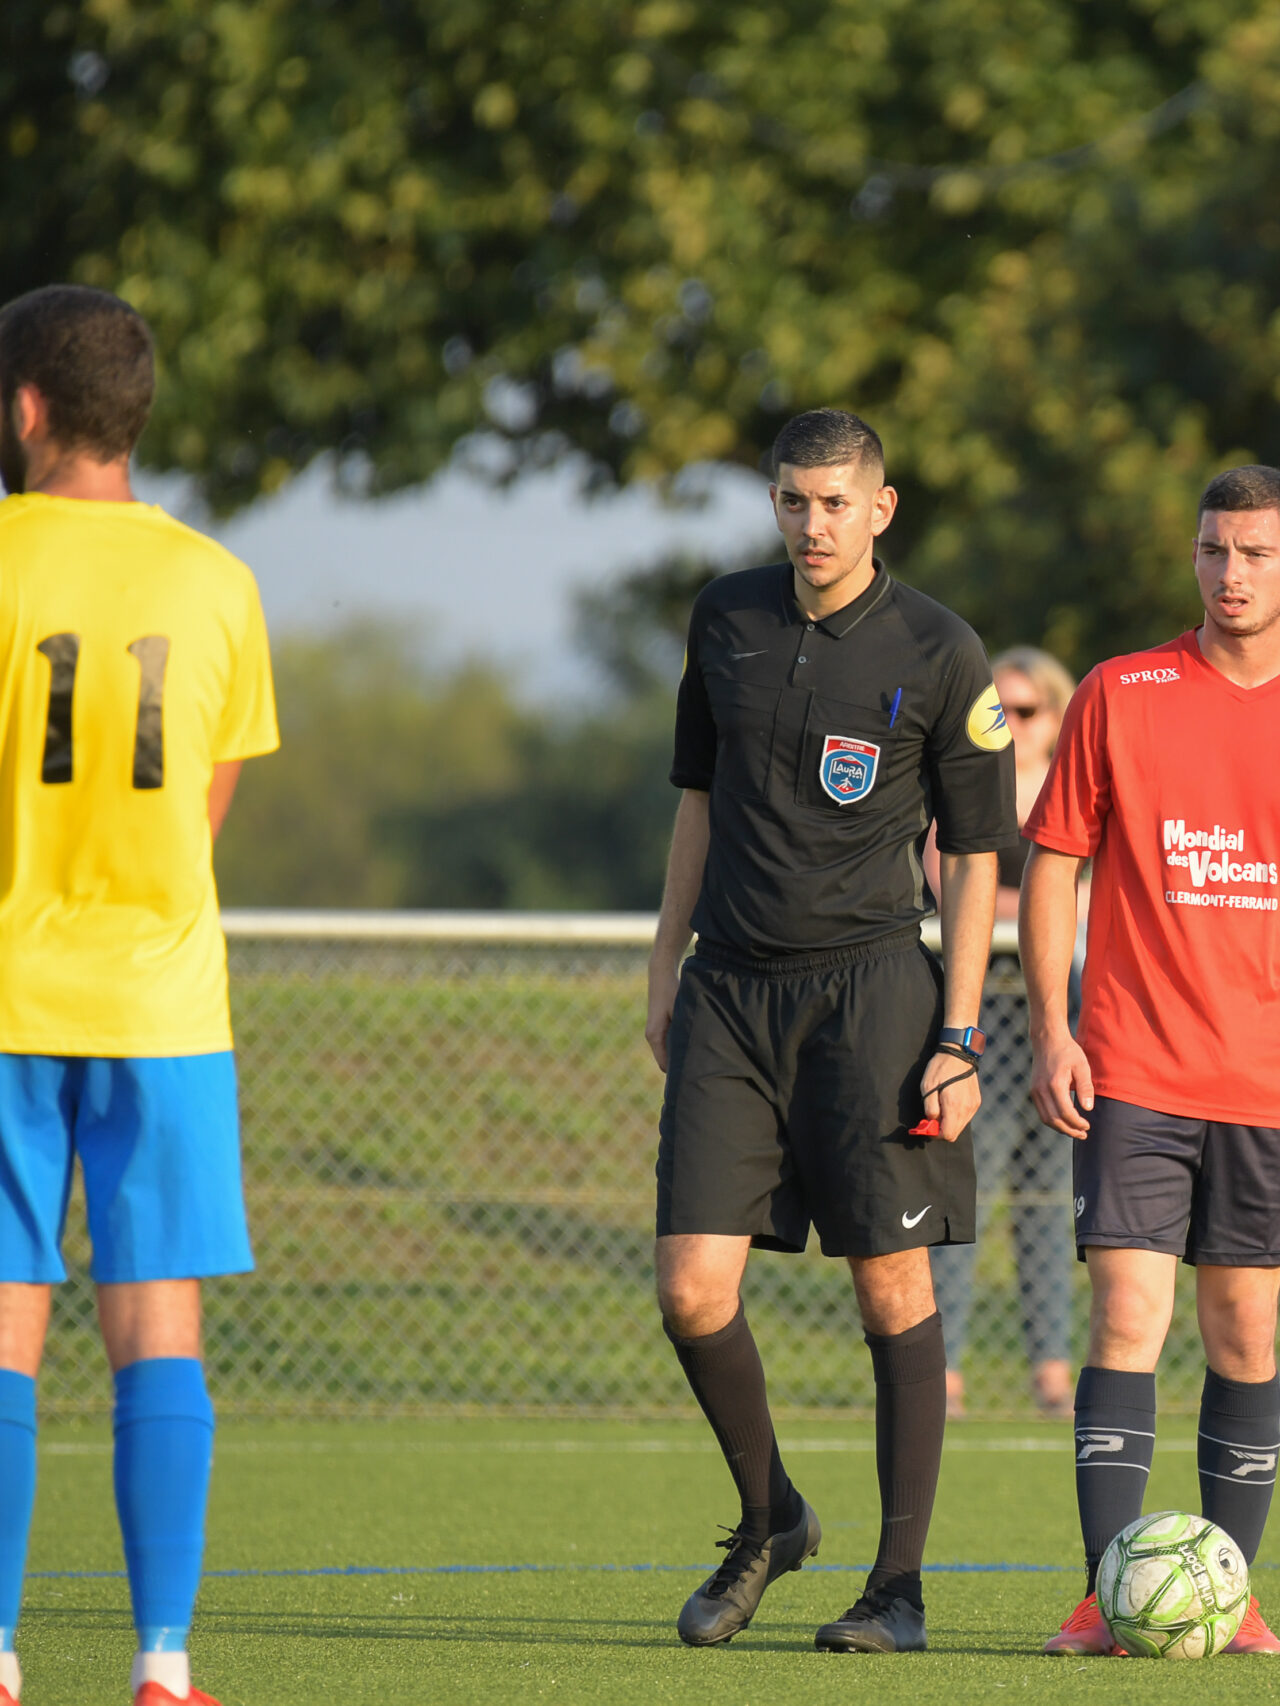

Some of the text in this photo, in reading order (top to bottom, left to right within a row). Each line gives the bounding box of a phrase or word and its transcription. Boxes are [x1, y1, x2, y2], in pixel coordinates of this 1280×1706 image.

[1120, 668, 1178, 685] SPROX
[37, 632, 170, 789] 11
[1163, 819, 1244, 852] Mondial
[1166, 851, 1278, 888] des Volcans
[1165, 890, 1278, 911] CLERMONT-FERRAND
[1178, 1543, 1216, 1607] uhlsport
